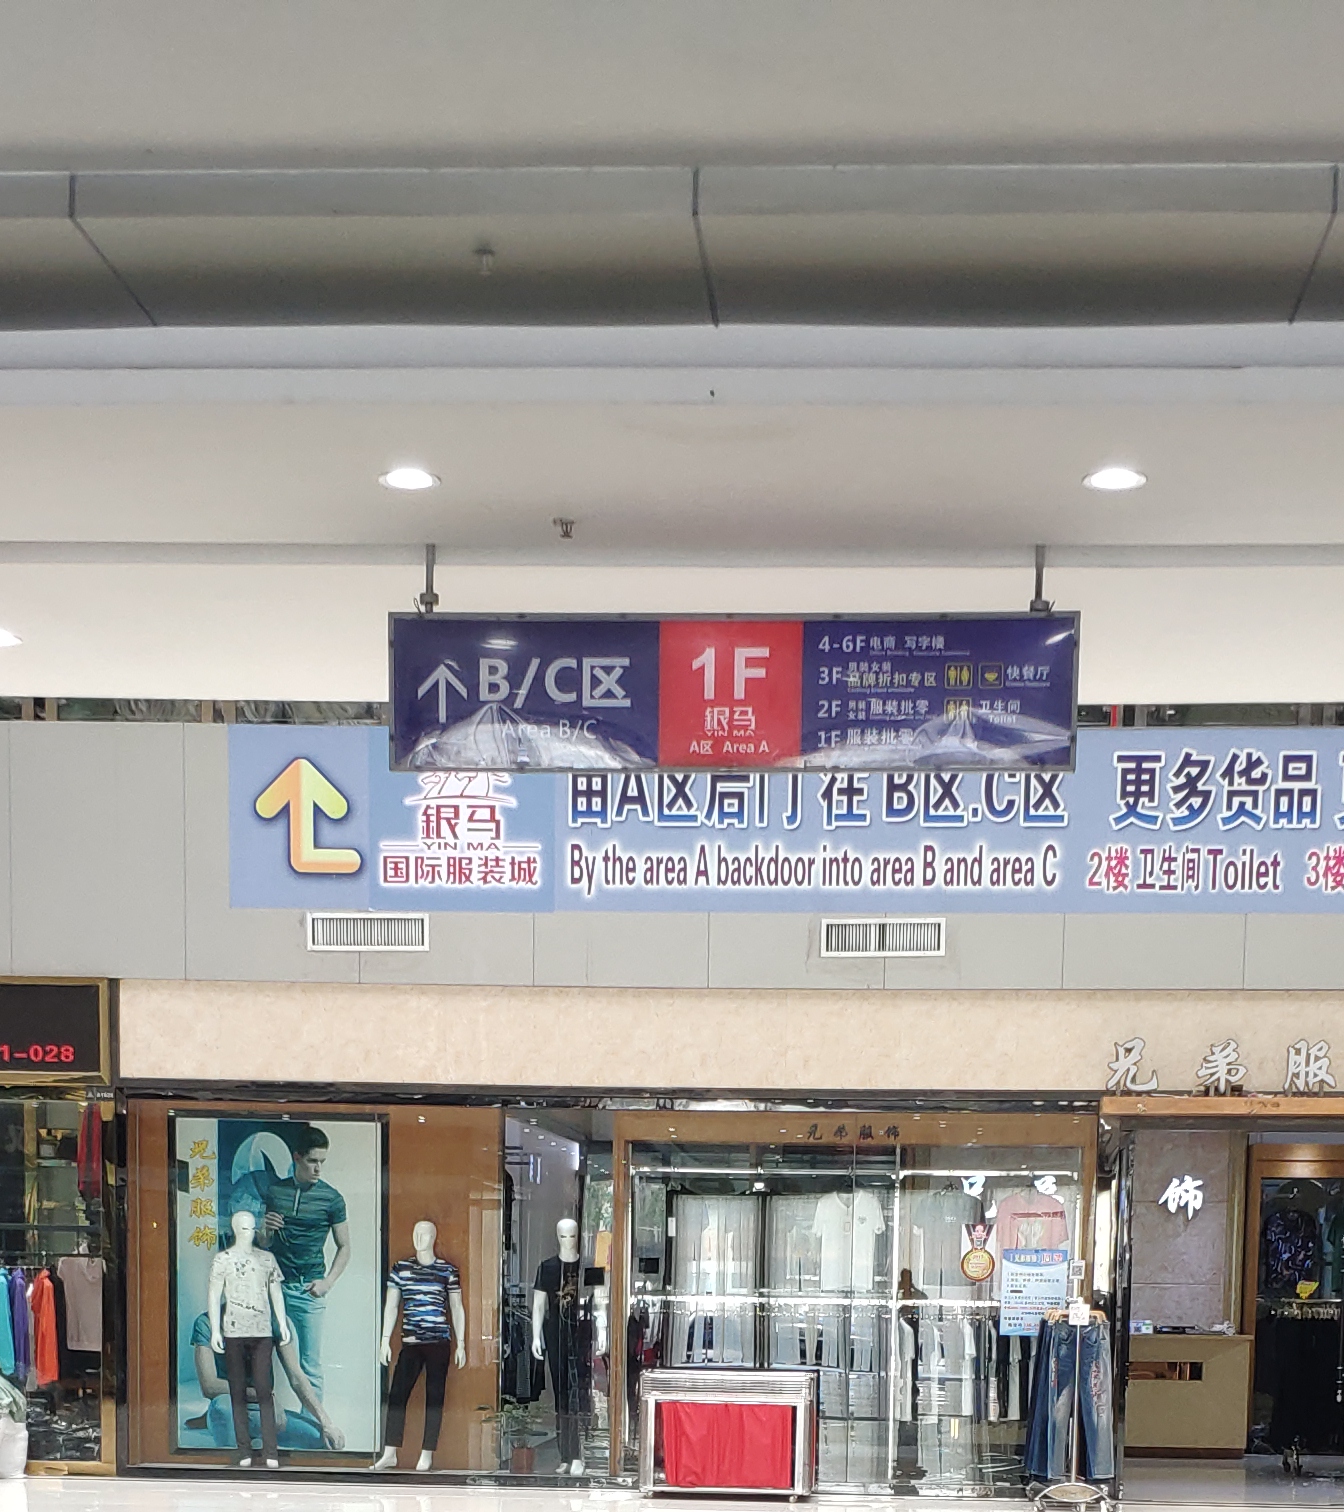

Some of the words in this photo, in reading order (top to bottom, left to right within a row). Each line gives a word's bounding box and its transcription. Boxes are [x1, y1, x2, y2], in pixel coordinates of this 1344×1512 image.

[818, 635, 866, 653] 4-6F
[479, 657, 632, 709] B/C区
[691, 646, 770, 700] 1F
[818, 667, 842, 685] 3F
[1006, 664, 1050, 680] 快餐厅
[817, 700, 842, 718] 2F
[978, 699, 1021, 713] 卫生间
[502, 720, 551, 738] Area
[559, 720, 597, 739] B/C
[817, 730, 841, 748] 1F
[689, 740, 714, 755] A区
[723, 740, 755, 753] Area
[758, 740, 770, 754] A
[1111, 750, 1321, 831] 更多货品
[422, 841, 458, 851] YIN
[466, 841, 501, 851] MA
[382, 855, 538, 885] 国际服装城
[570, 843, 597, 895] By
[603, 845, 636, 886] the
[643, 856, 687, 887] area
[695, 845, 710, 886] A
[717, 844, 815, 887] backdoor
[822, 844, 863, 887] into
[870, 857, 914, 887] area
[922, 845, 937, 887] B
[944, 845, 983, 887] and
[990, 857, 1035, 888] area
[1042, 845, 1057, 887] C
[1087, 846, 1130, 892] 2楼
[1207, 848, 1281, 891] Toilet
